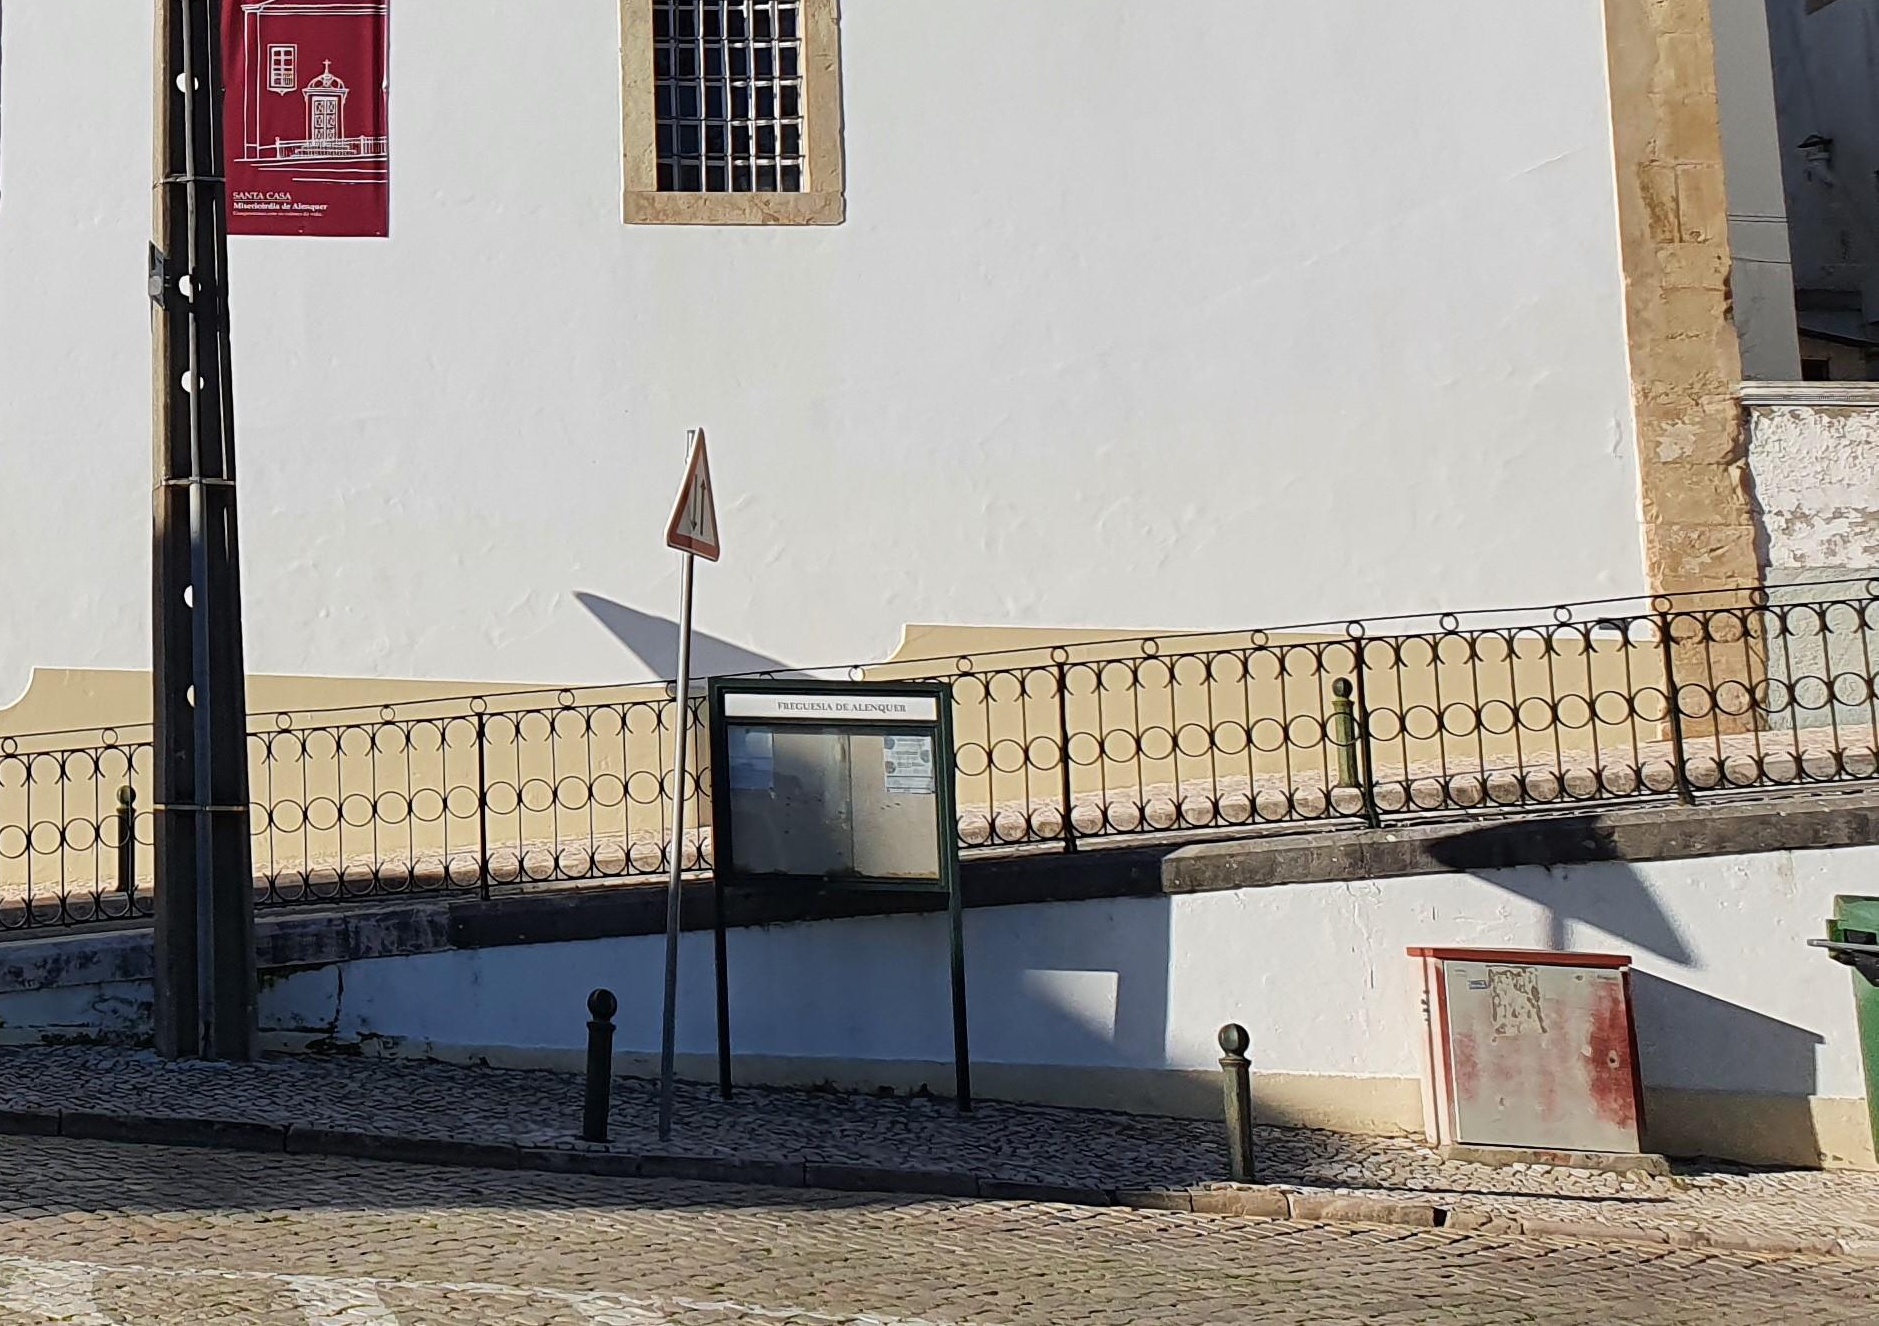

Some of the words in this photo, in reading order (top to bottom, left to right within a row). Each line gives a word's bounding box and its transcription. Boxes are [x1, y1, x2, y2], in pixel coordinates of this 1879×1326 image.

[233, 192, 264, 200] SANTA
[266, 192, 292, 200] CASA
[777, 701, 833, 711] FREGUESIA
[835, 703, 849, 711] DE
[851, 703, 907, 714] ALENQUER
